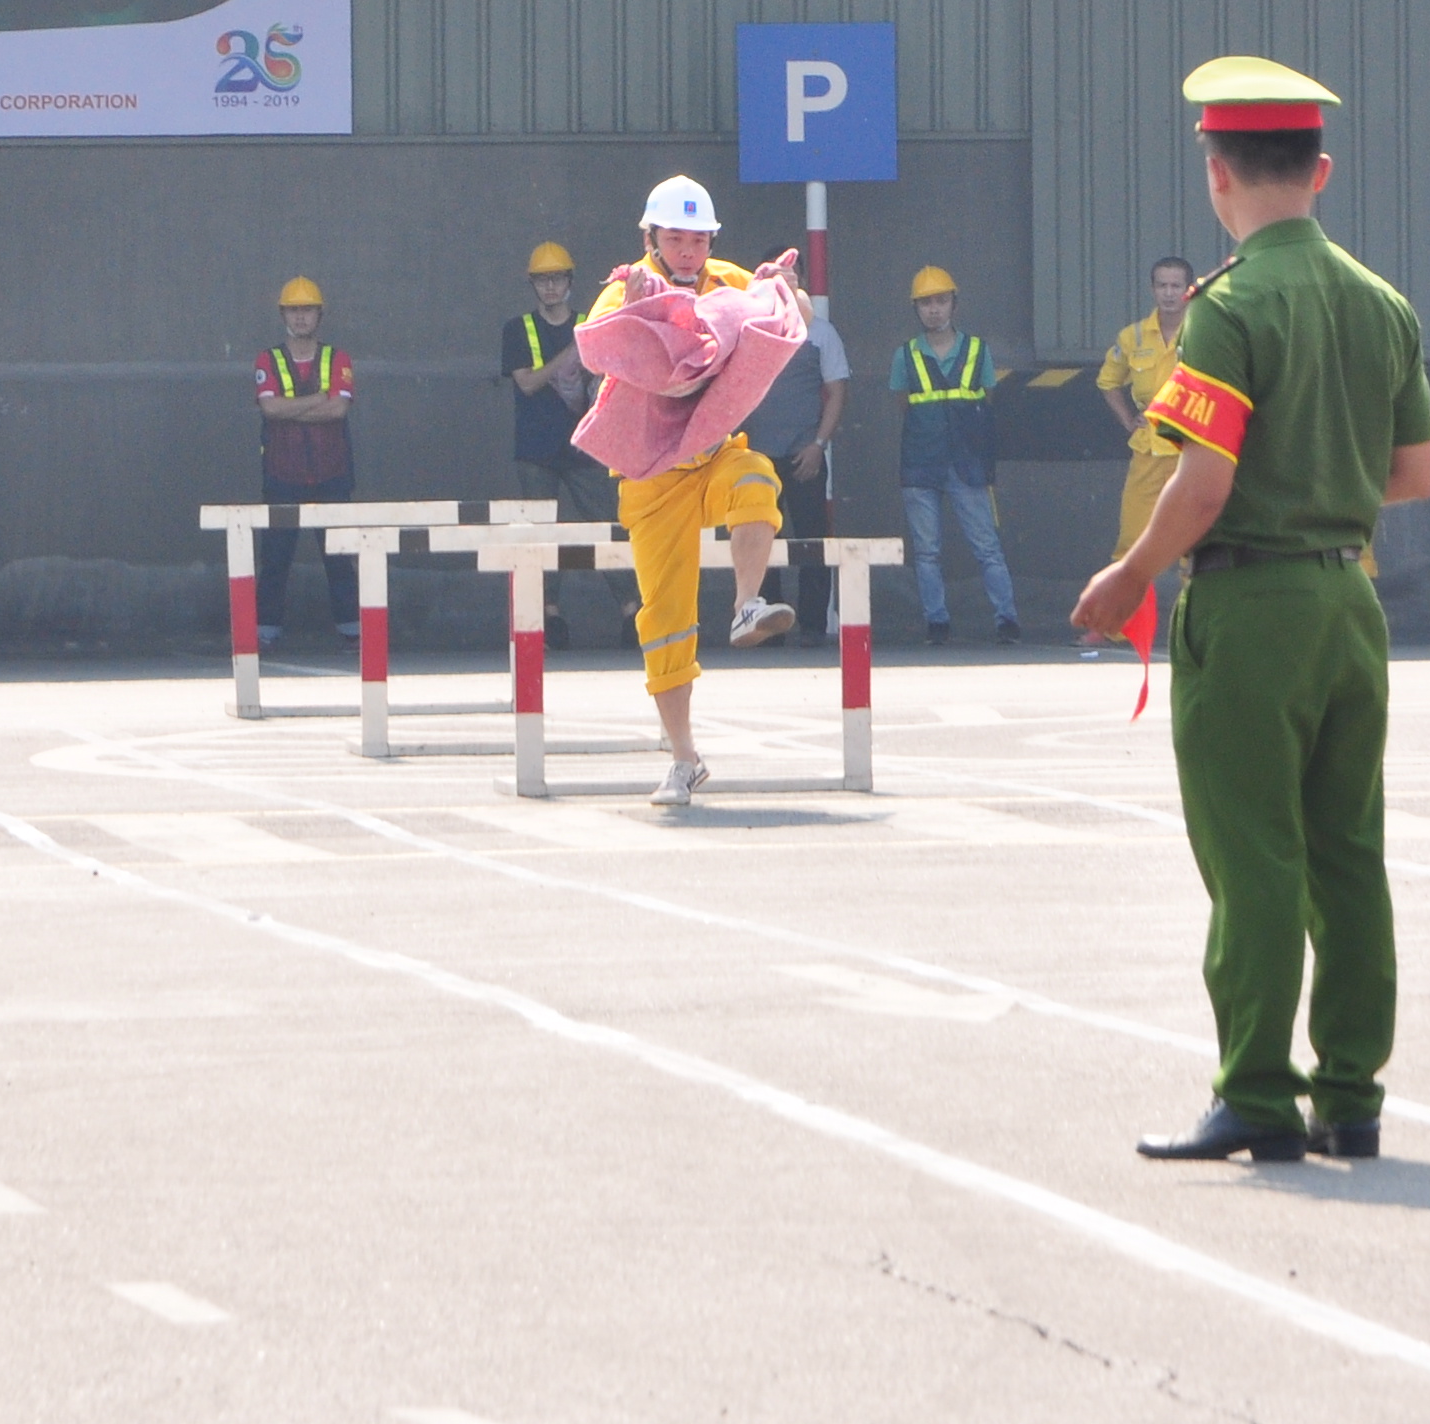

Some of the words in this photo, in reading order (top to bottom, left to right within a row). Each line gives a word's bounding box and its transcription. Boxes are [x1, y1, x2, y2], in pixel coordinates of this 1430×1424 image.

[0, 94, 138, 112] CORPORATION
[212, 95, 248, 108] 1994
[263, 94, 301, 107] 2019
[786, 60, 848, 142] P
[1182, 389, 1217, 426] TÀI
